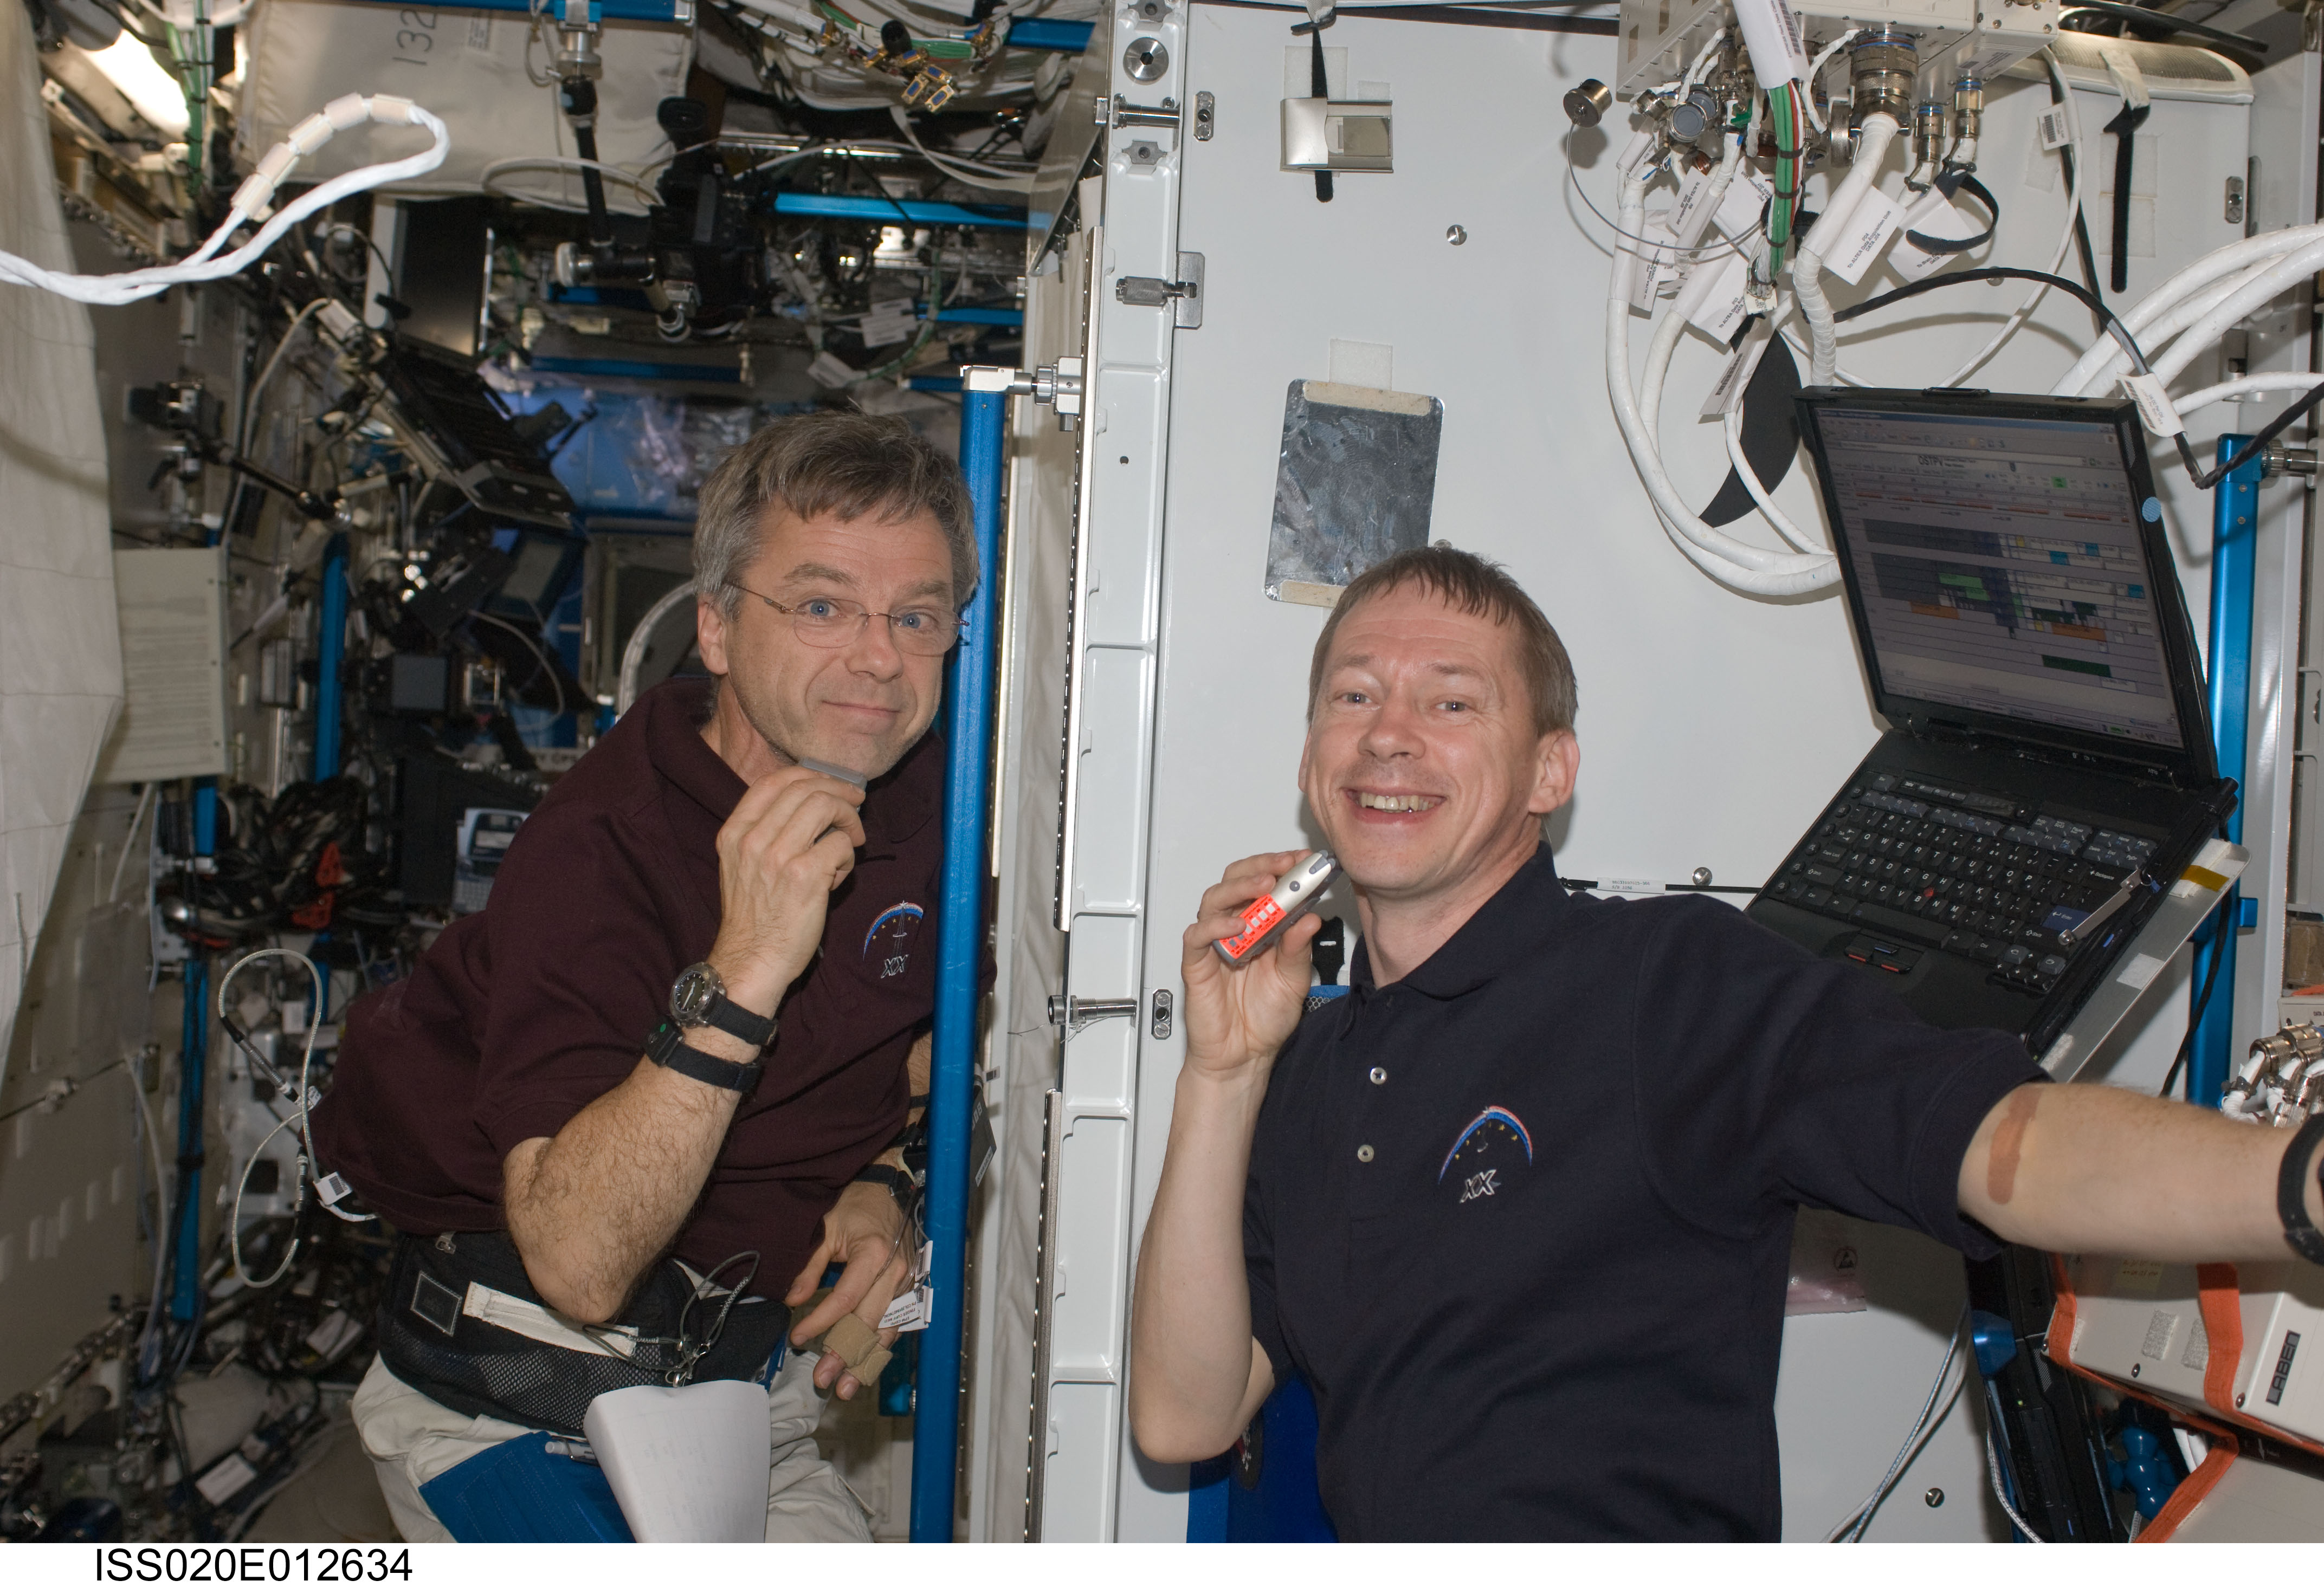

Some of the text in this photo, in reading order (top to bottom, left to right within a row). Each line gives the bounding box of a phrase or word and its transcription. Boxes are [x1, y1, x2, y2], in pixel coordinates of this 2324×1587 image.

[392, 9, 436, 65] 132
[1851, 250, 1863, 263] ALTEA
[1861, 241, 1870, 250] Data
[1868, 219, 1885, 241] Acquisition
[1883, 210, 1892, 219] Unit
[1865, 241, 1875, 252] DATA
[1722, 313, 1733, 324] ALTEA
[1460, 1169, 1497, 1203] XX
[2266, 1331, 2301, 1405] LABEN
